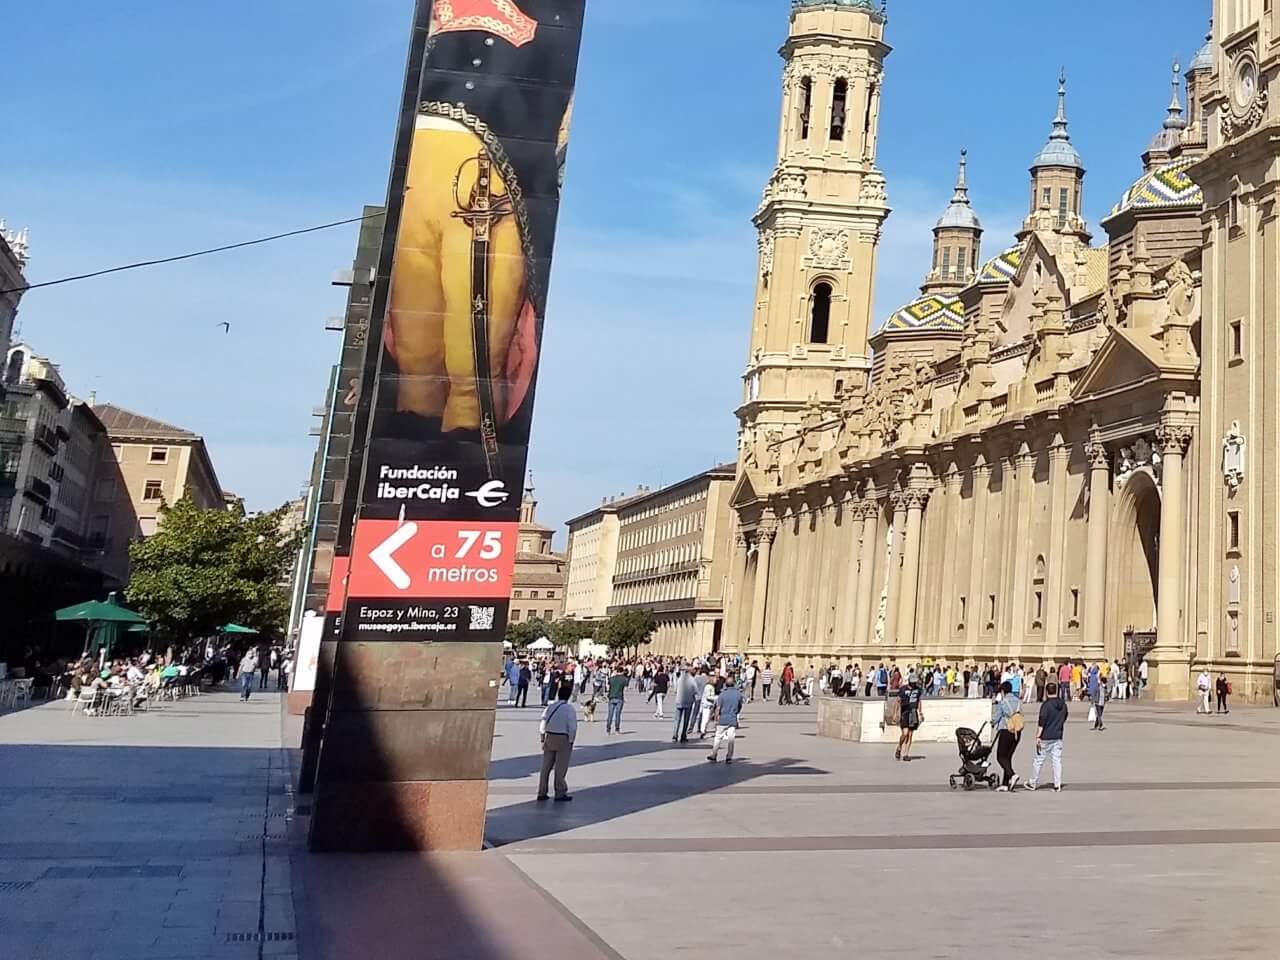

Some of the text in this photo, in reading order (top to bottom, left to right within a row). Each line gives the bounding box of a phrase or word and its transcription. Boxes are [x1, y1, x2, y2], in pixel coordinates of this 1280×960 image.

[379, 465, 457, 480] Fundación
[377, 483, 460, 503] iberCaja
[431, 531, 503, 558] a 75
[427, 565, 498, 582] metros
[359, 606, 459, 621] Espoz y Mina, 23
